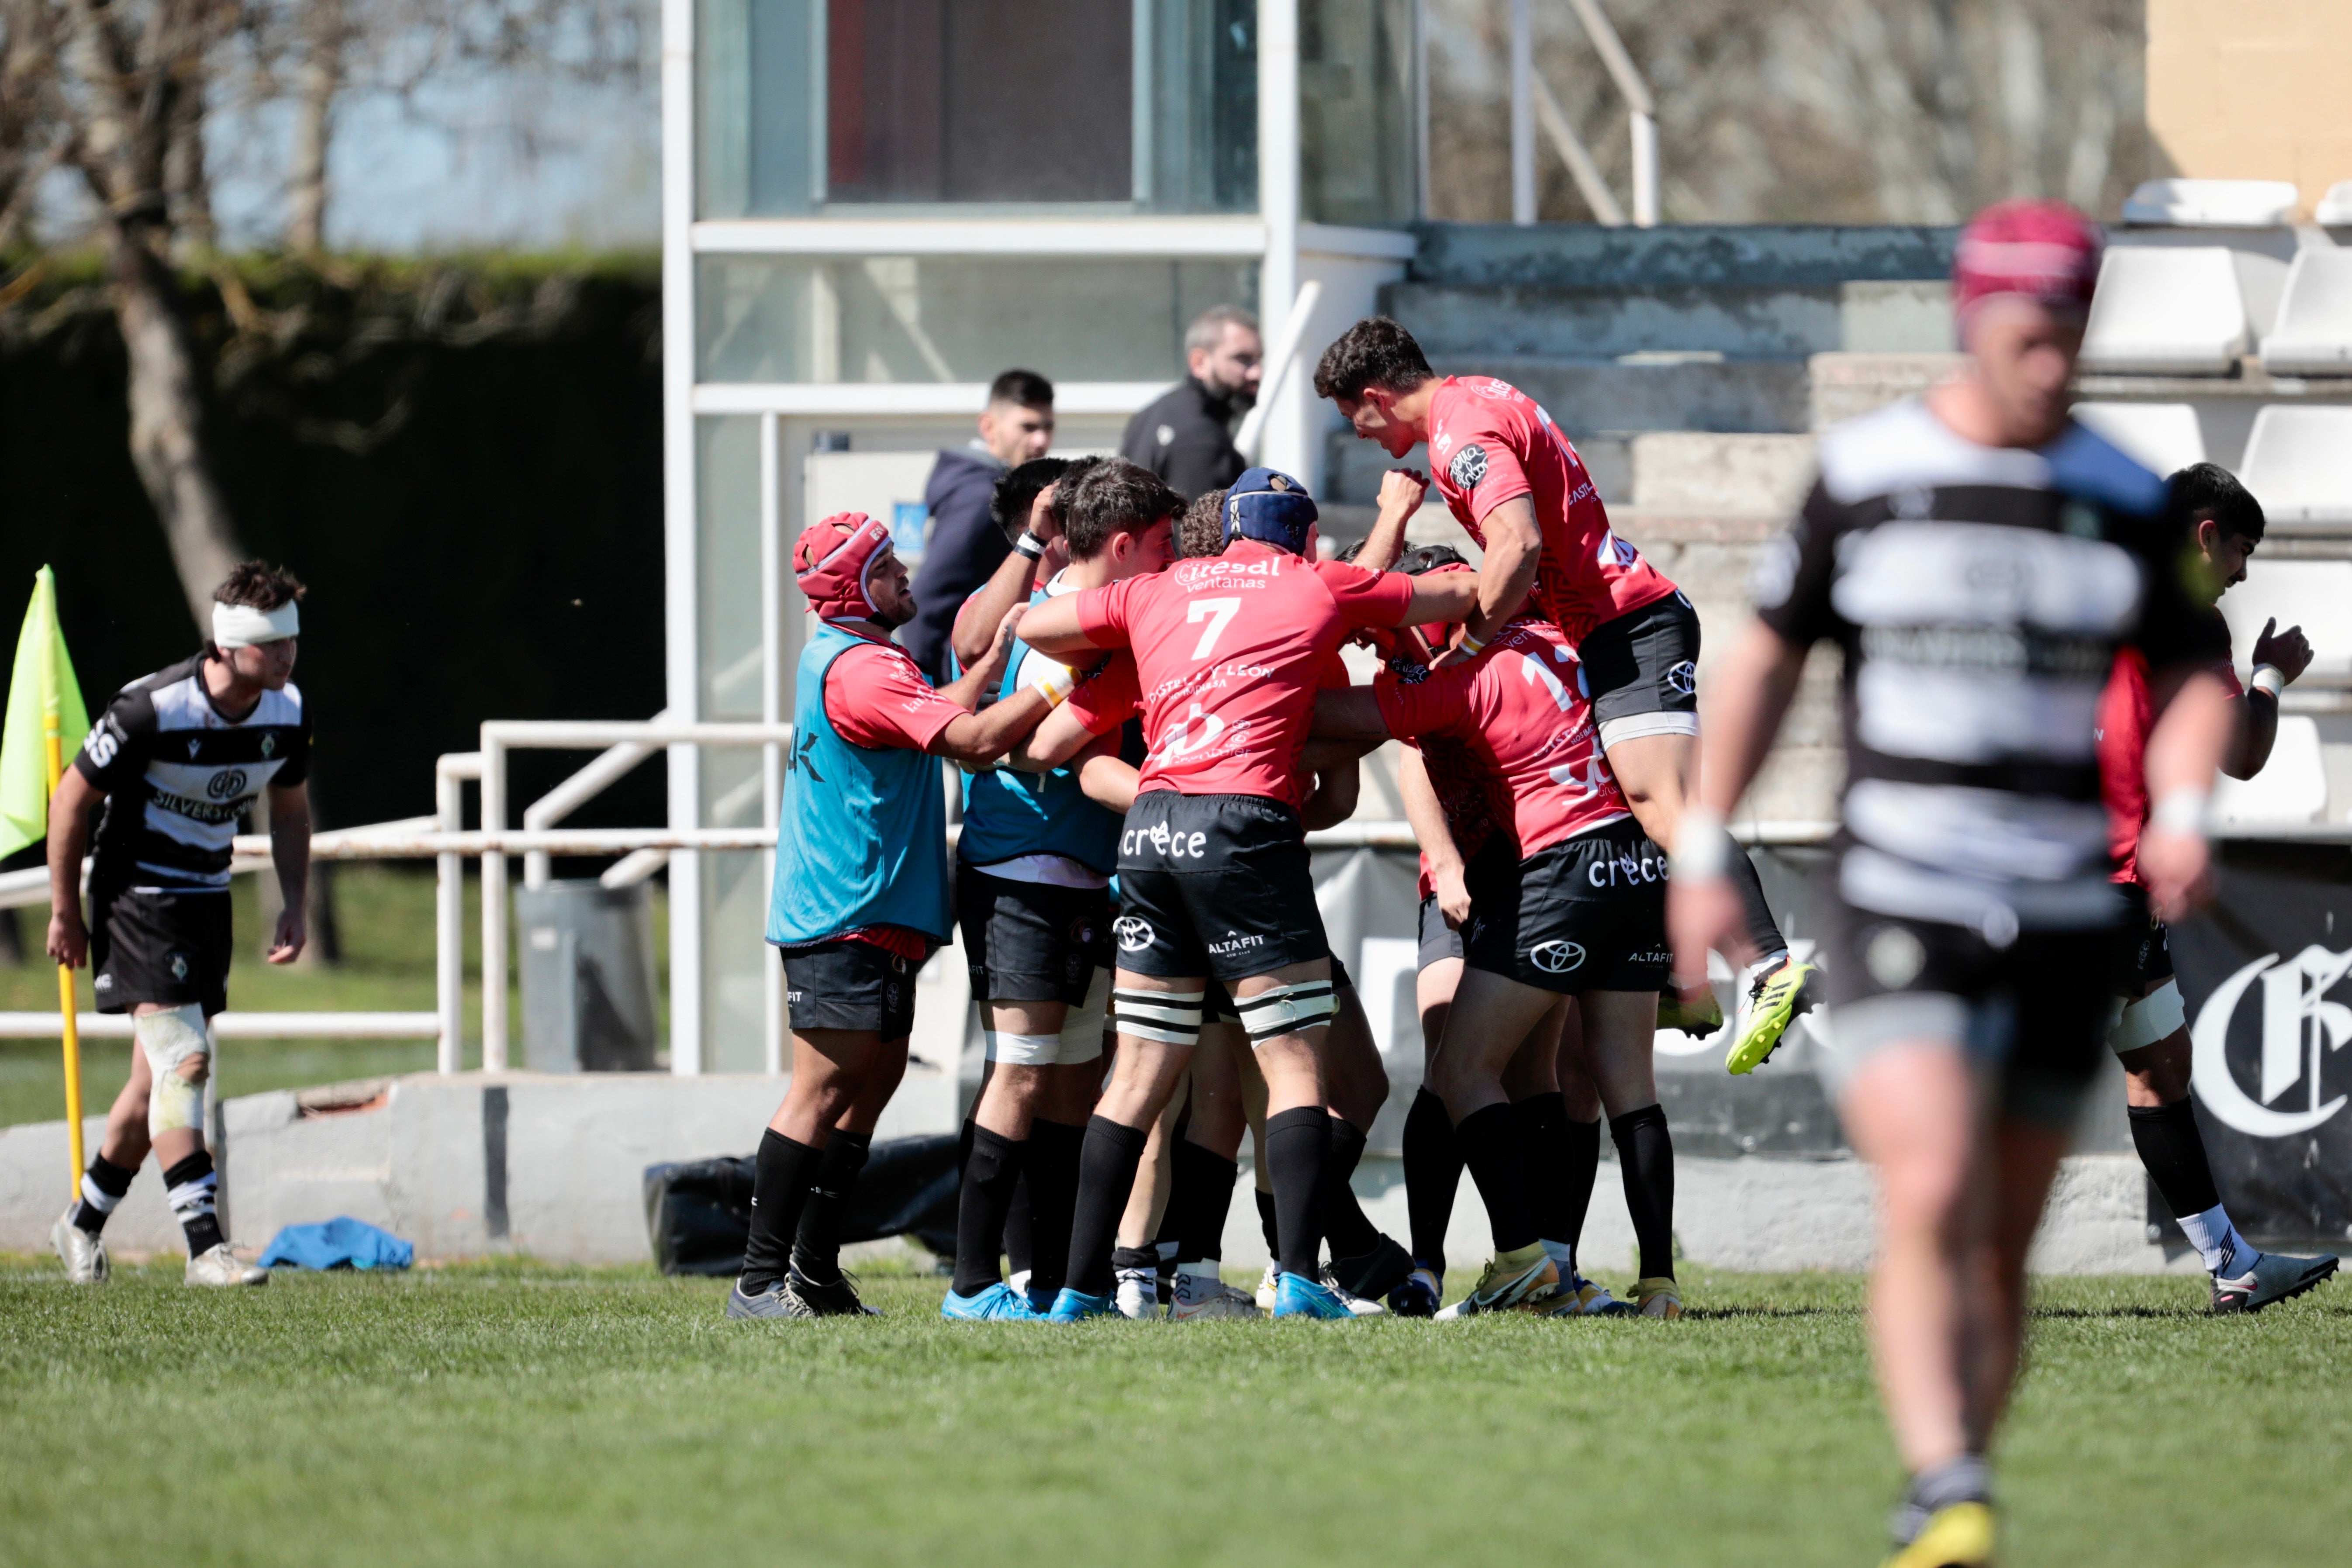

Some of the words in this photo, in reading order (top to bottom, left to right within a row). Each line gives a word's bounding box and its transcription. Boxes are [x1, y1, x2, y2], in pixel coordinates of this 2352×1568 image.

[1187, 576, 1265, 593] ventanas
[1187, 597, 1241, 661] 7
[1209, 665, 1221, 680] Y
[1123, 820, 1207, 858] crece
[1209, 934, 1264, 954] ALTAFIT
[1628, 952, 1674, 963] ALTAFIT
